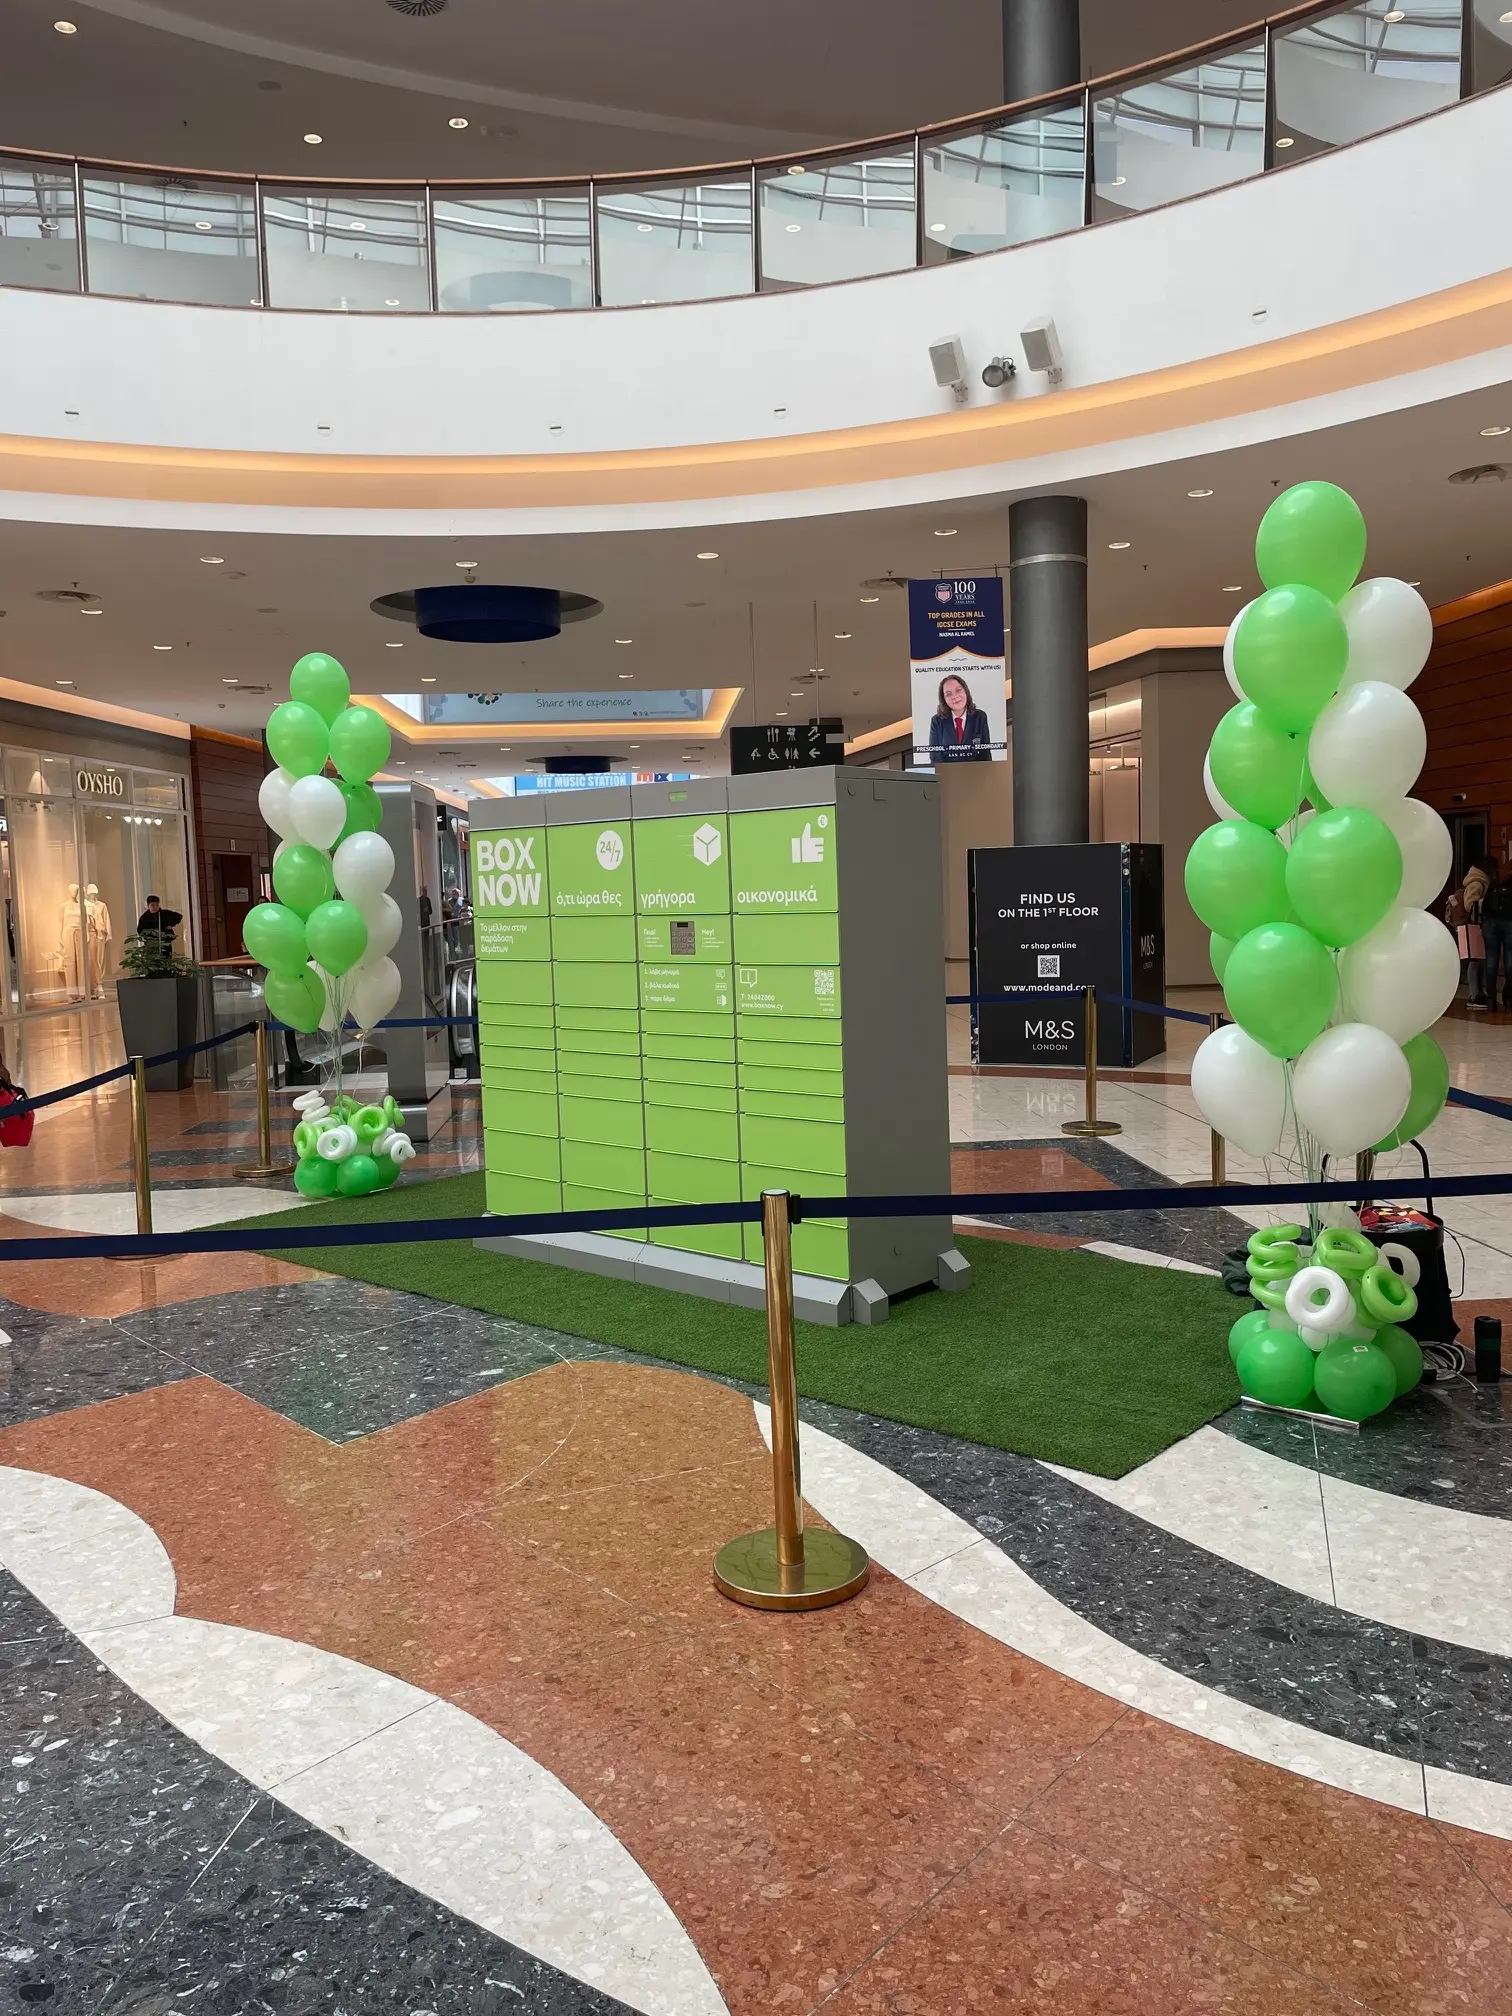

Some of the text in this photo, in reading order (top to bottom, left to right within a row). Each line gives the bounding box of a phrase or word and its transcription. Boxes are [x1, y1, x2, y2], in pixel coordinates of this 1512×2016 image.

[953, 581, 976, 594] 100
[536, 698, 632, 709] Share the experience
[77, 770, 123, 796] OYSHO
[536, 775, 626, 788] HIT MUSIC STATION
[476, 837, 536, 871] BOX
[599, 840, 621, 863] 24/7
[478, 873, 542, 907] NOW
[737, 885, 817, 906] οικονομικά
[576, 890, 601, 908] ώρα
[602, 889, 622, 907] θες
[641, 889, 696, 908] γρήγορα
[1020, 892, 1076, 905] FIND US
[998, 909, 1015, 918] ON
[1018, 908, 1040, 918] THE
[1059, 906, 1099, 917] FLOOR
[480, 923, 487, 932] Το
[511, 924, 527, 933] στην
[1031, 942, 1050, 950] shop
[1051, 941, 1077, 949] online
[1025, 1020, 1075, 1040] M&S
[1032, 1043, 1068, 1051] LONDON
